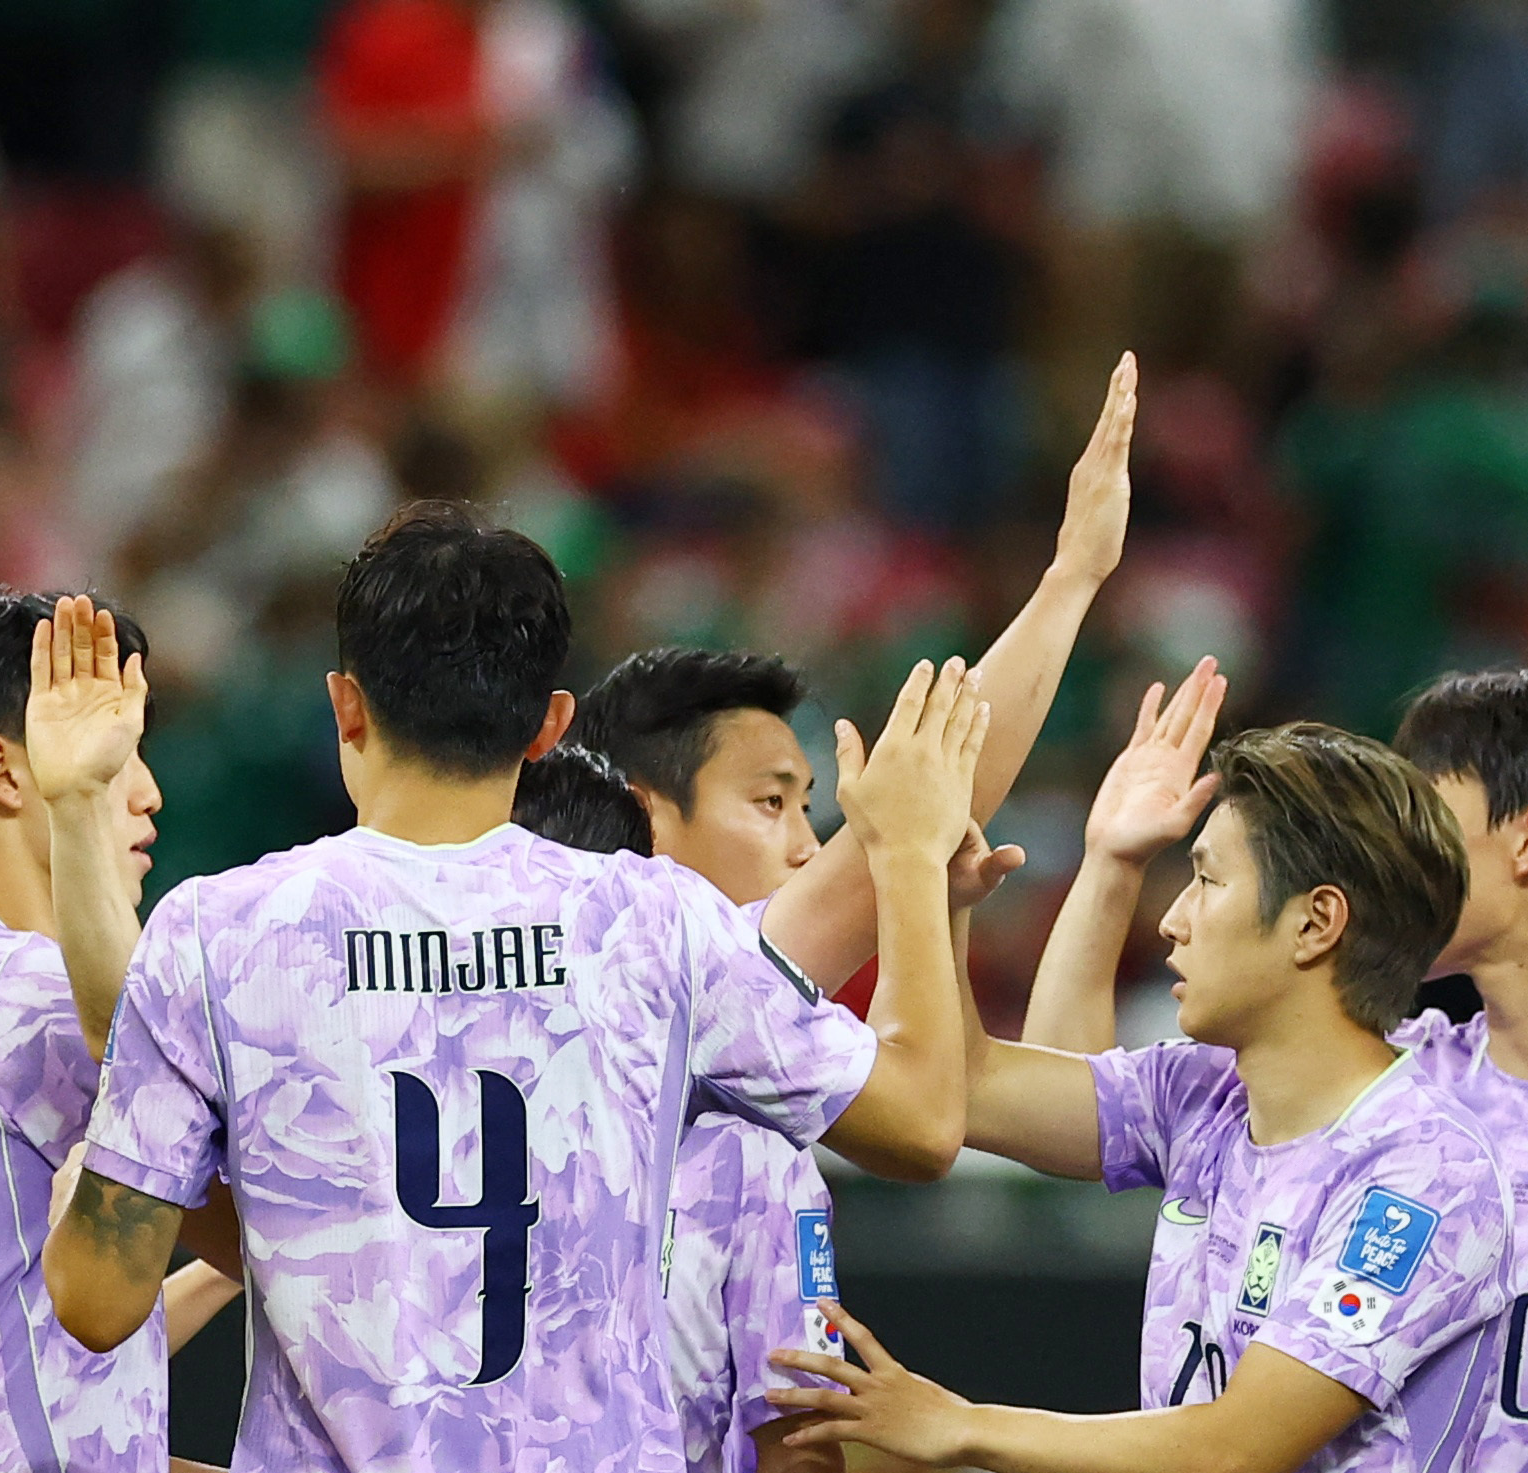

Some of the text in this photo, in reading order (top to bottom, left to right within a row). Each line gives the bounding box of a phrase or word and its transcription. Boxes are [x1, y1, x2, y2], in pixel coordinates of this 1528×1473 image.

[344, 923, 567, 995] MINJAE
[386, 1069, 541, 1388] 4
[1359, 1242, 1400, 1271] PEACE
